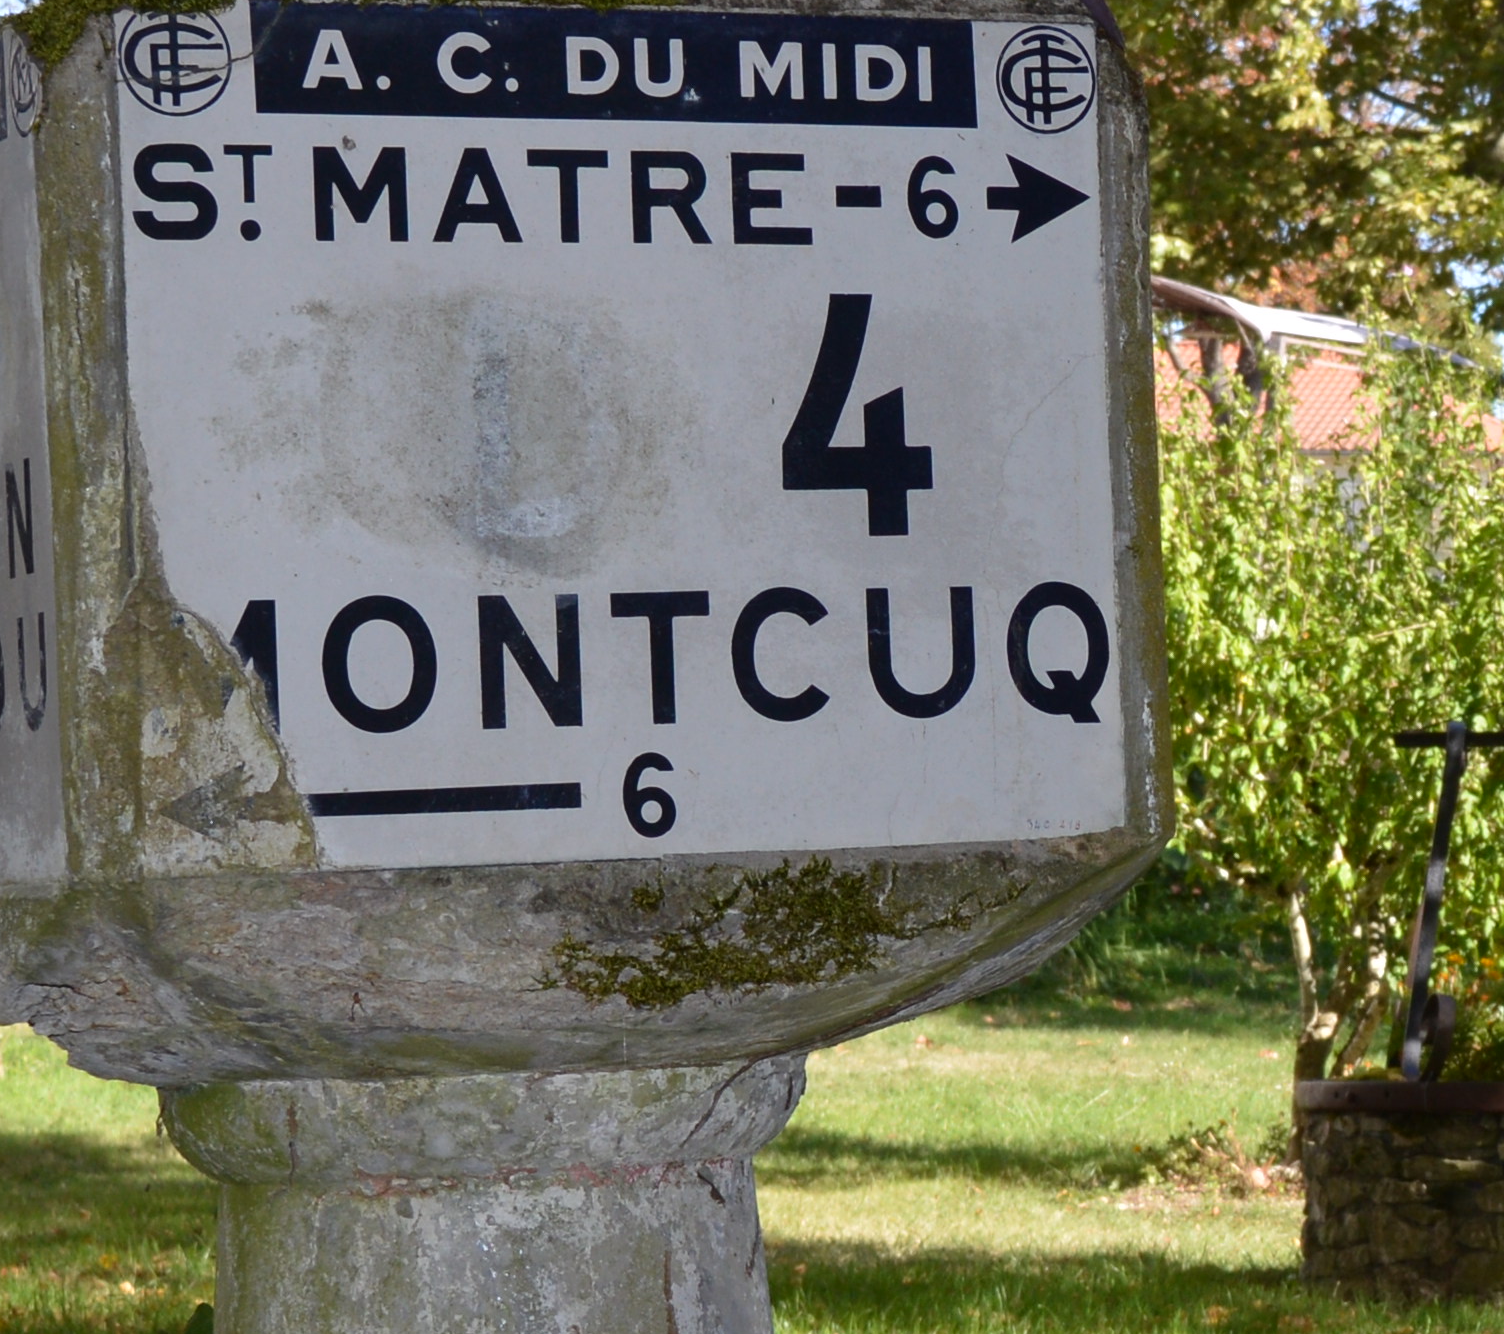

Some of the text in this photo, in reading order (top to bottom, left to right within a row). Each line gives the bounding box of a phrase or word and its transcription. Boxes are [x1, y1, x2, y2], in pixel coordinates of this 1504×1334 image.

[302, 28, 932, 103] A. C. DU MIDI
[782, 293, 934, 537] 4
[621, 751, 677, 838] 6
